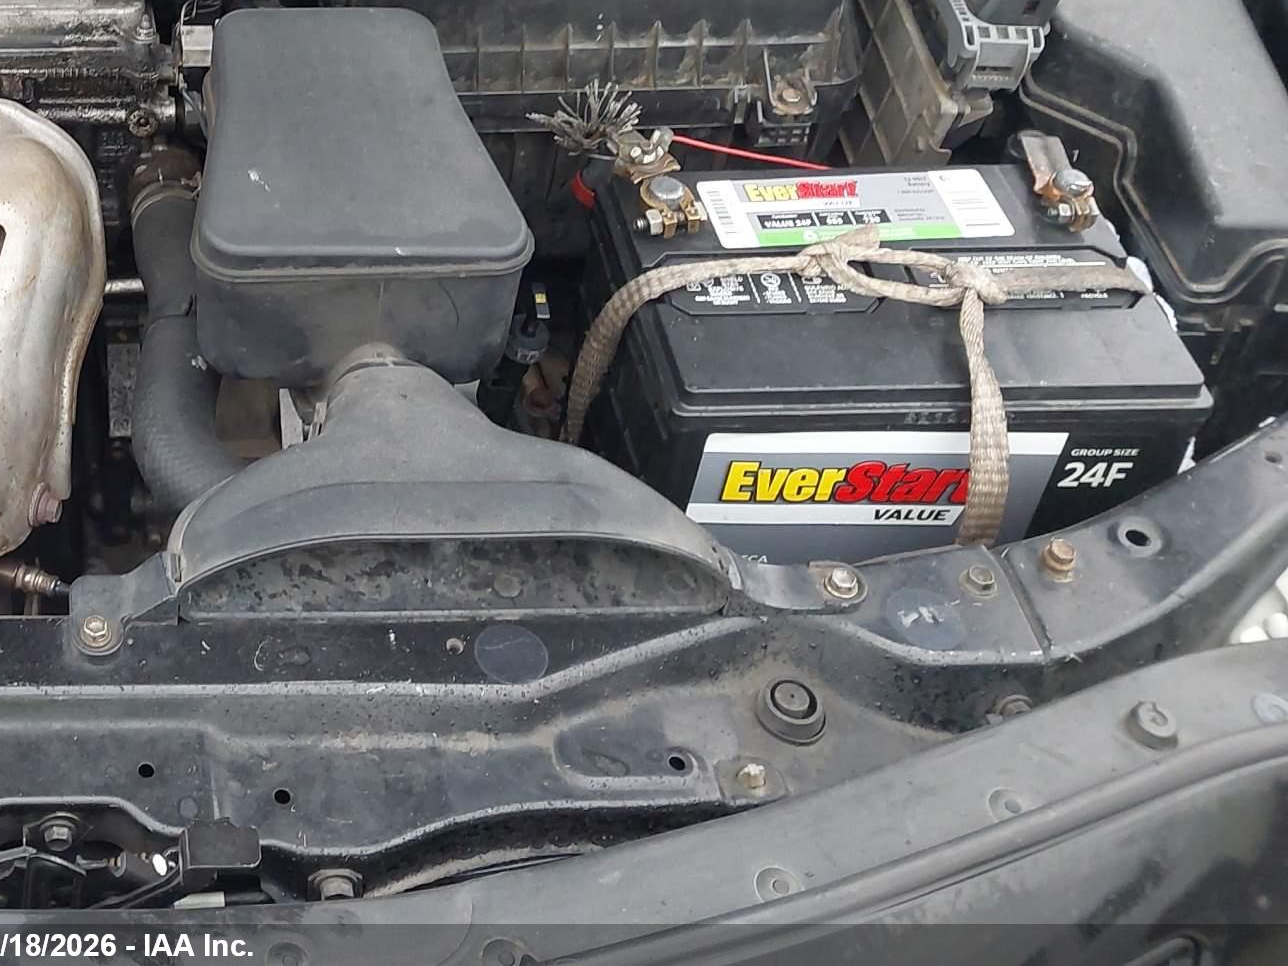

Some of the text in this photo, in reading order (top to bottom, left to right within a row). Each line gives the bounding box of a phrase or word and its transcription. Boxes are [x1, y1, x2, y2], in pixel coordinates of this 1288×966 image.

[1070, 447, 1142, 457] GROUP SIZE
[1056, 460, 1134, 489] 24F
[873, 507, 952, 522] VALUE
